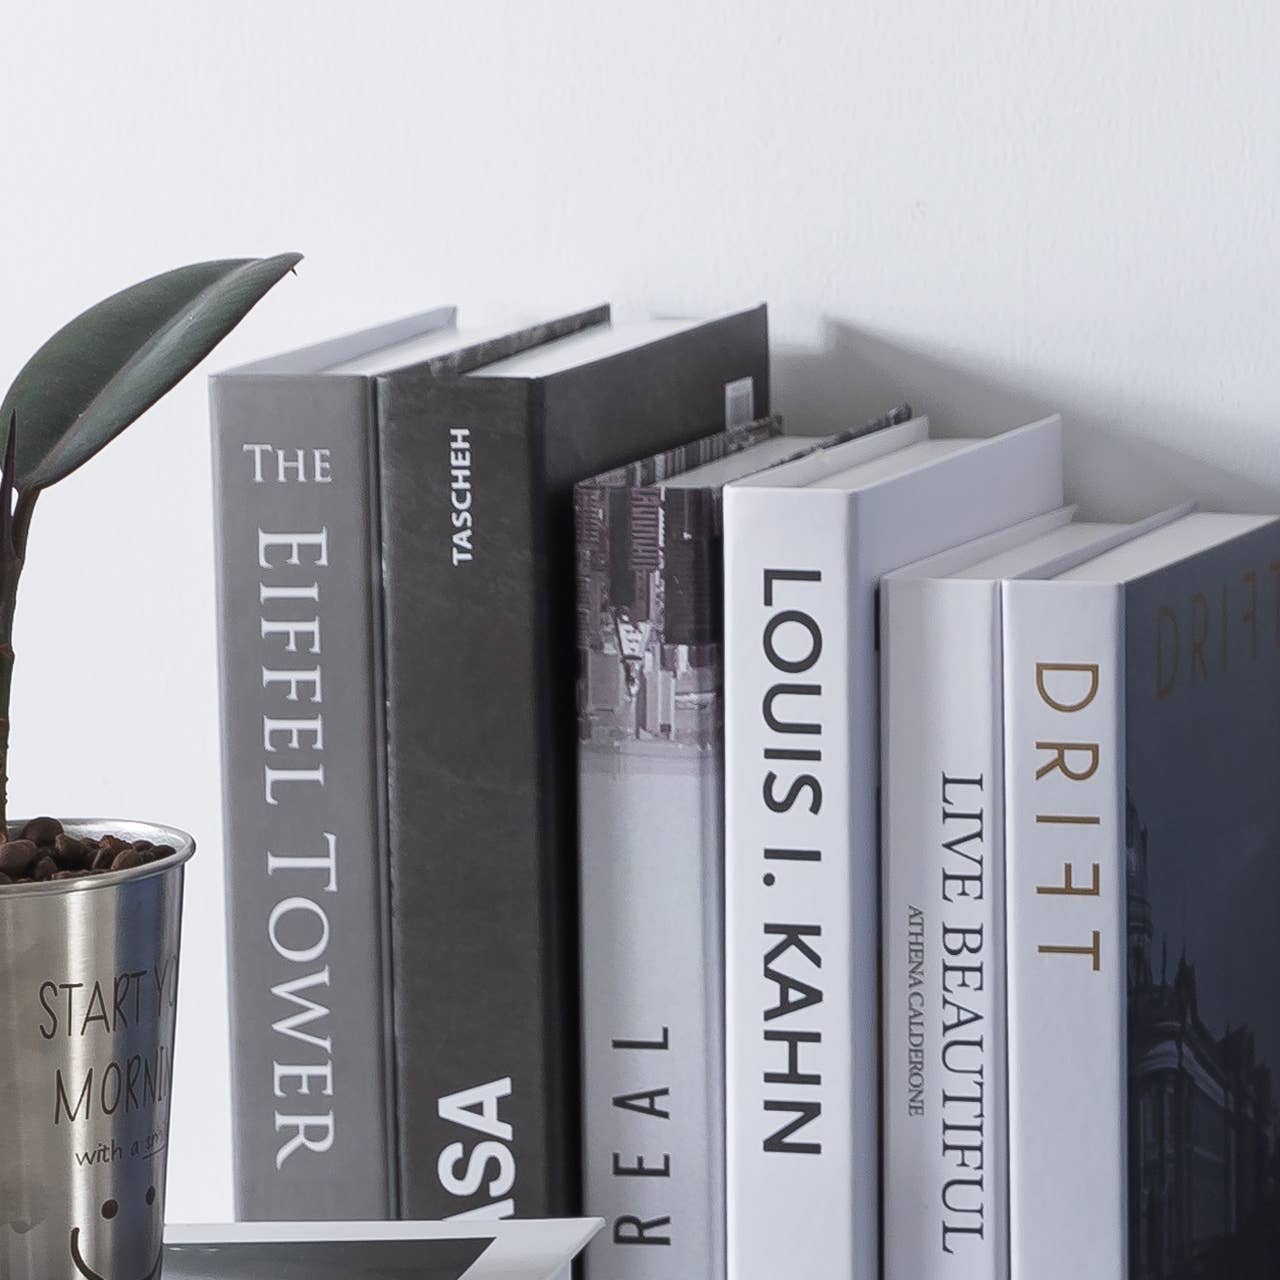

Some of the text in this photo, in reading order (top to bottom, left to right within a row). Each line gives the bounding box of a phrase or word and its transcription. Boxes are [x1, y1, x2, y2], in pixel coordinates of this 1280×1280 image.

[450, 428, 474, 566] TASCHEH
[257, 526, 337, 1171] EIFFEL TOWER
[762, 567, 823, 1155] LOUIS I. KAHN
[1035, 662, 1100, 971] DRIFT
[40, 971, 147, 1040] START
[908, 905, 925, 1117] ATHENA CALDERONE
[941, 771, 984, 1253] LIVE BEAUTIFUL
[75, 1138, 123, 1165] with
